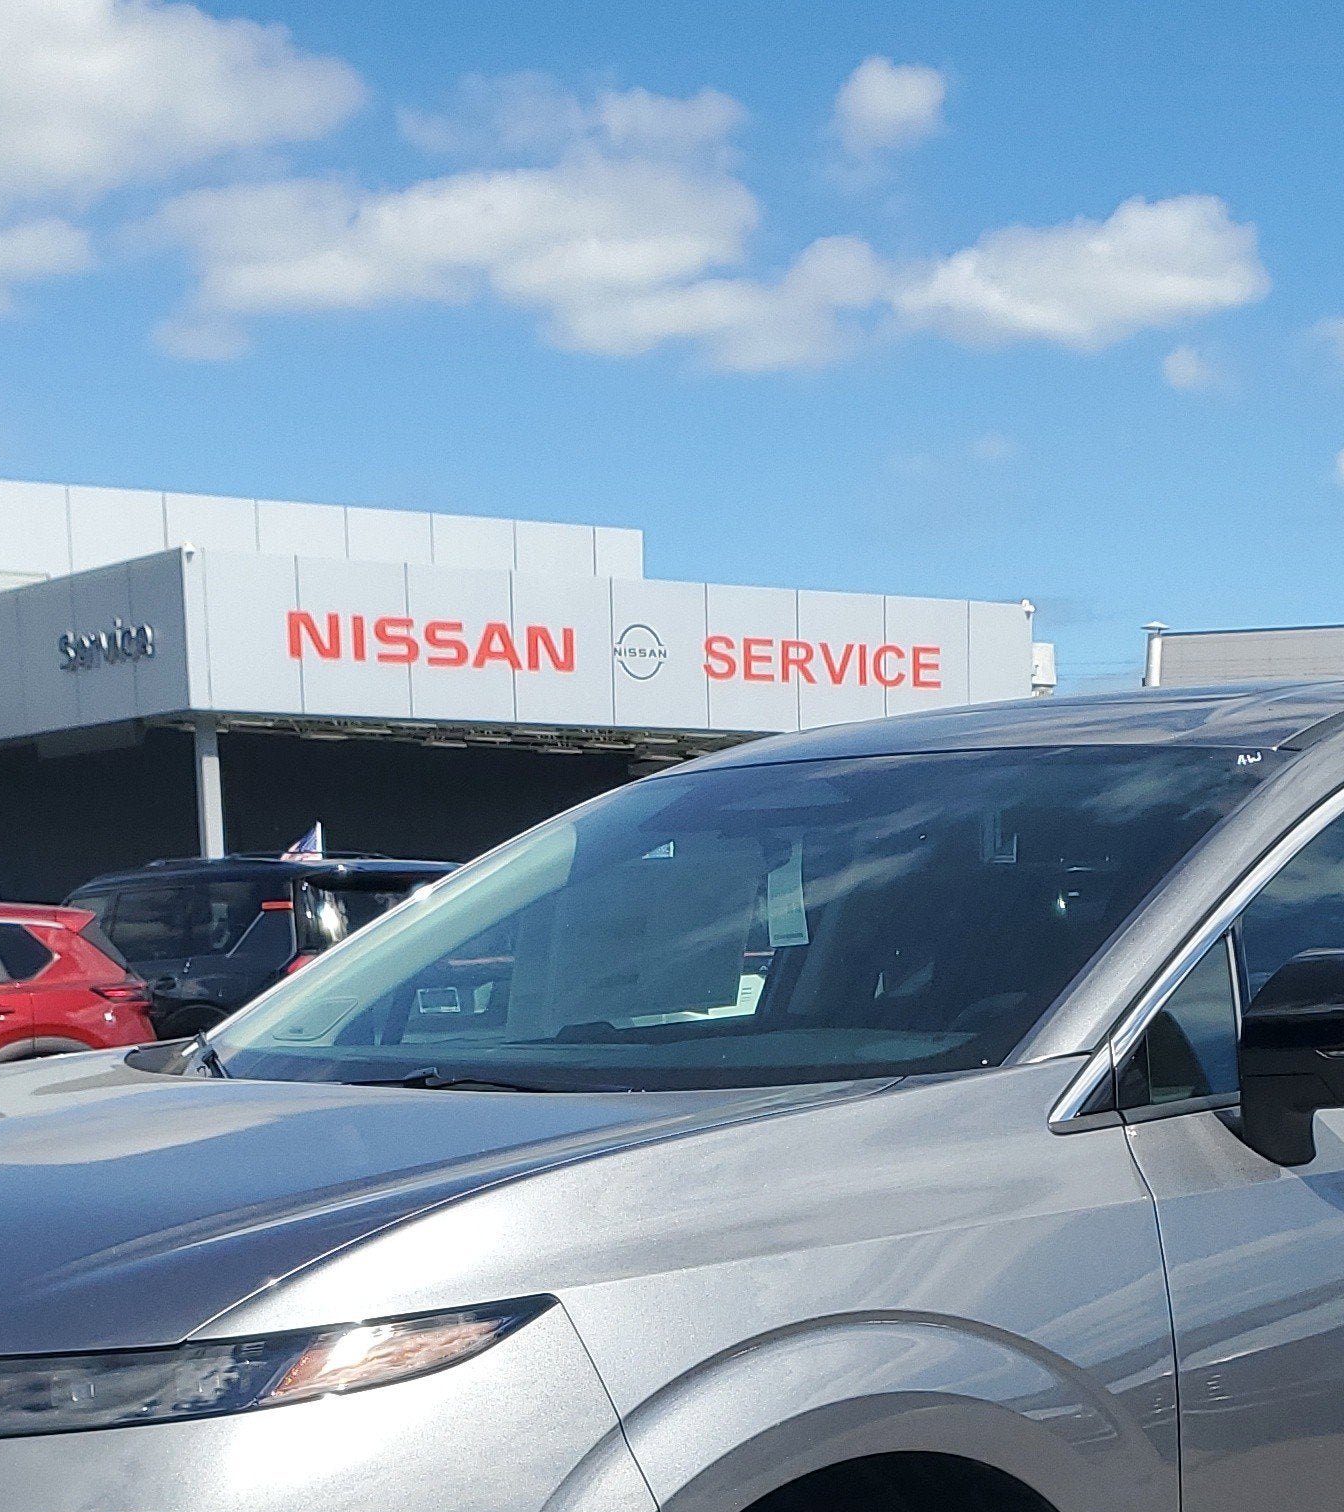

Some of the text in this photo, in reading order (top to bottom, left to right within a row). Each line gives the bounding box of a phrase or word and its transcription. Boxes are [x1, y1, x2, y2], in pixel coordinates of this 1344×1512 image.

[58, 616, 155, 671] Service
[287, 611, 943, 688] NISSAN SERVICE
[613, 647, 667, 658] NISSAN
